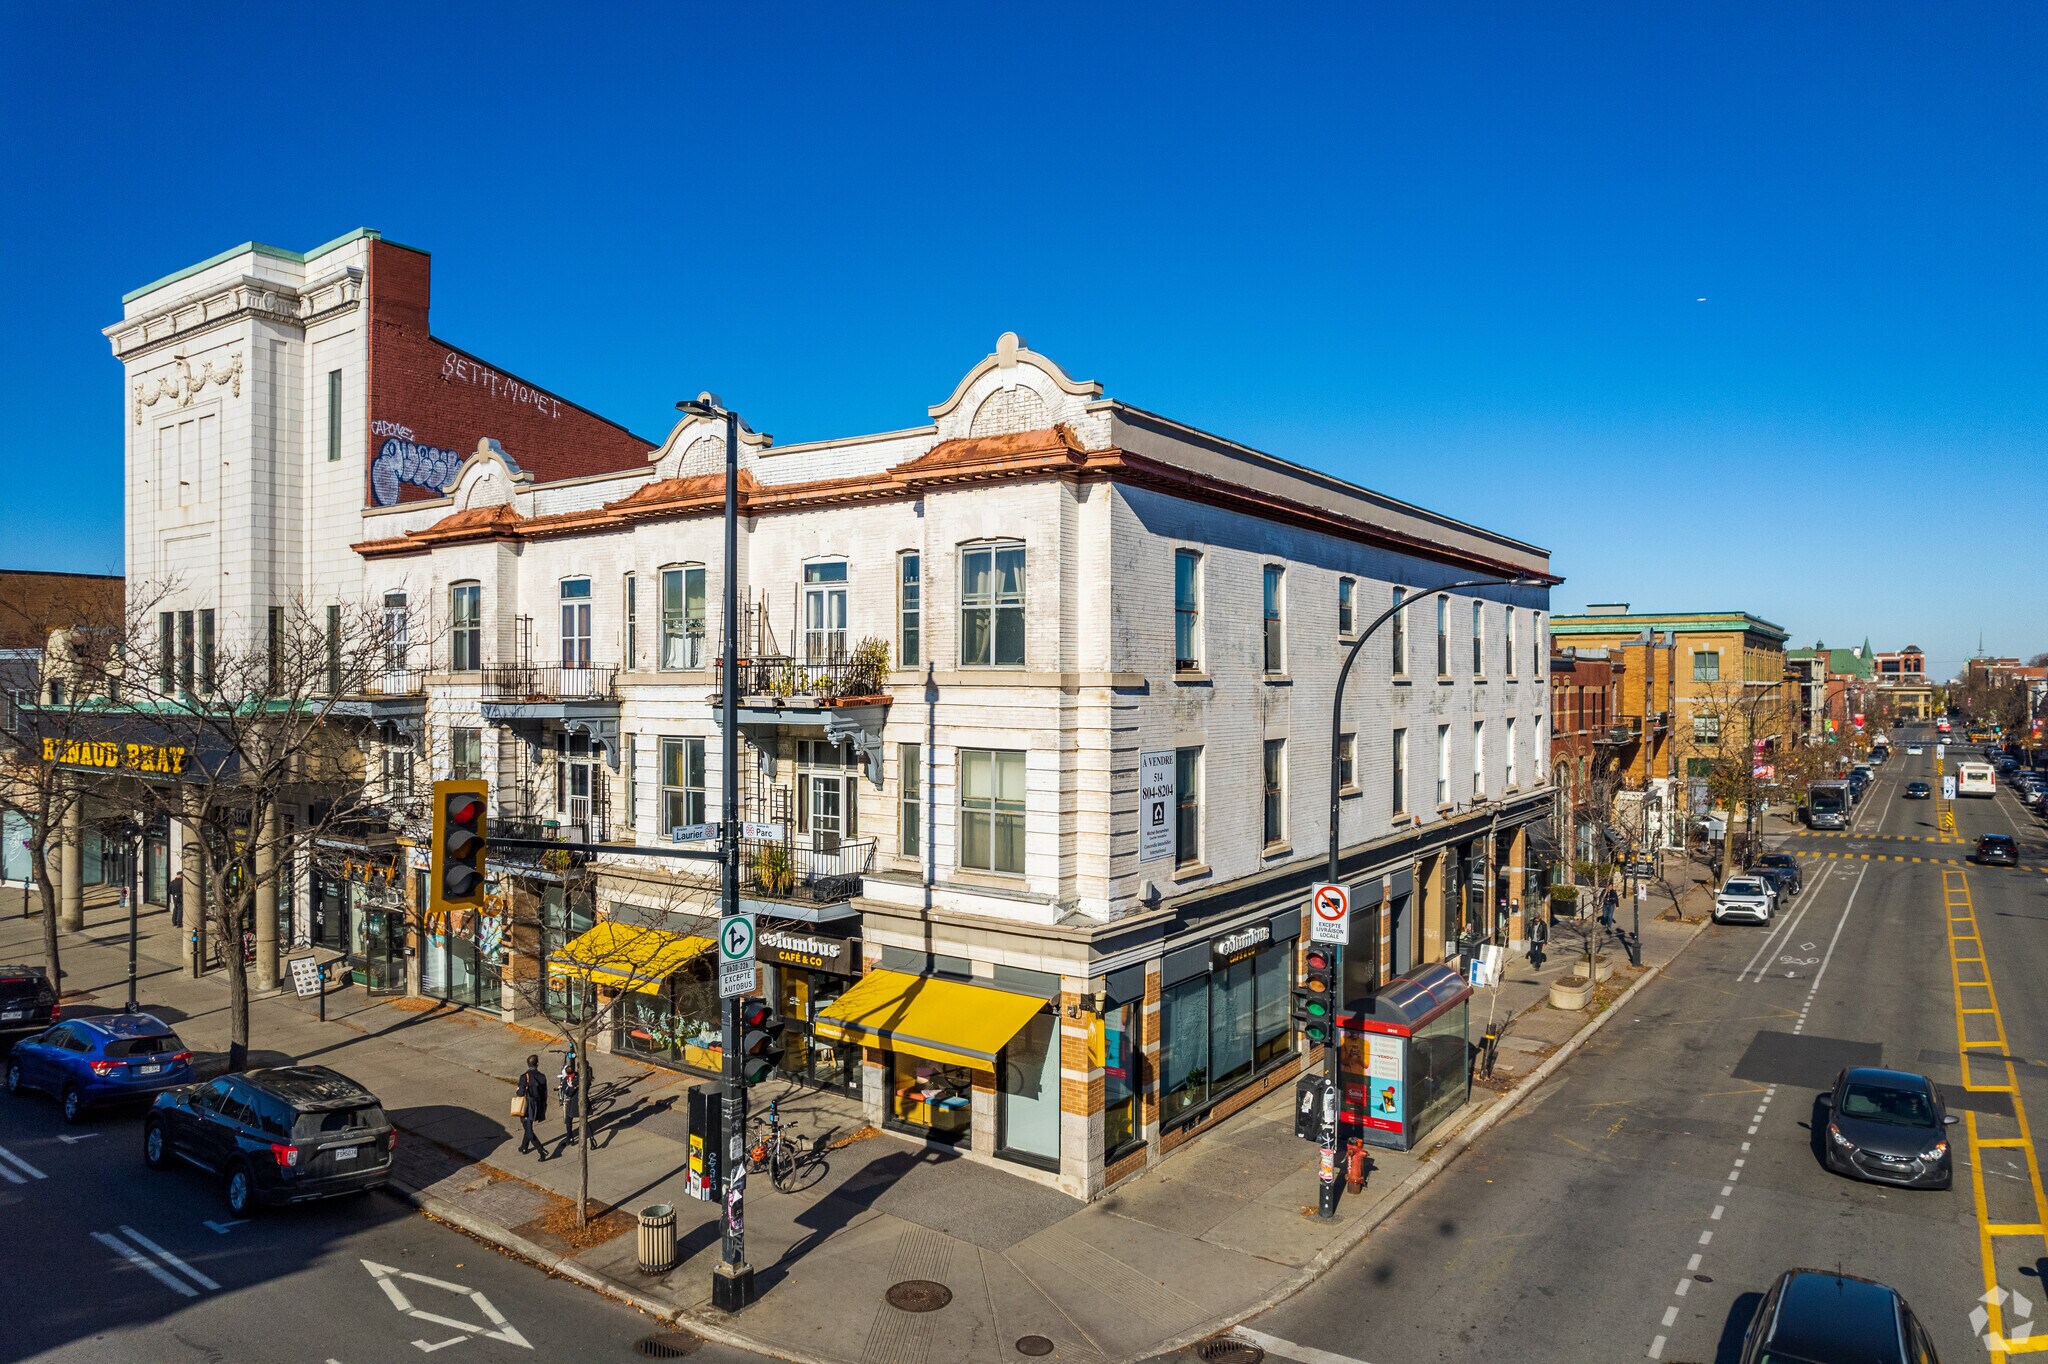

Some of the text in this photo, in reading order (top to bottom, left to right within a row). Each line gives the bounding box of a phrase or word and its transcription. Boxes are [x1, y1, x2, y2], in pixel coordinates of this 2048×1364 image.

[1142, 755, 1174, 768] À VENDRE
[1153, 773, 1163, 782] 514
[1142, 784, 1174, 800] 804-8204
[676, 830, 703, 841] Laurier
[756, 828, 773, 838] Parc
[1218, 926, 1270, 956] columbus
[1319, 932, 1340, 940] LOCALE
[758, 932, 841, 958] columbus
[778, 951, 823, 967] CAFÉ & CO
[724, 980, 753, 994] AUTOBUS
